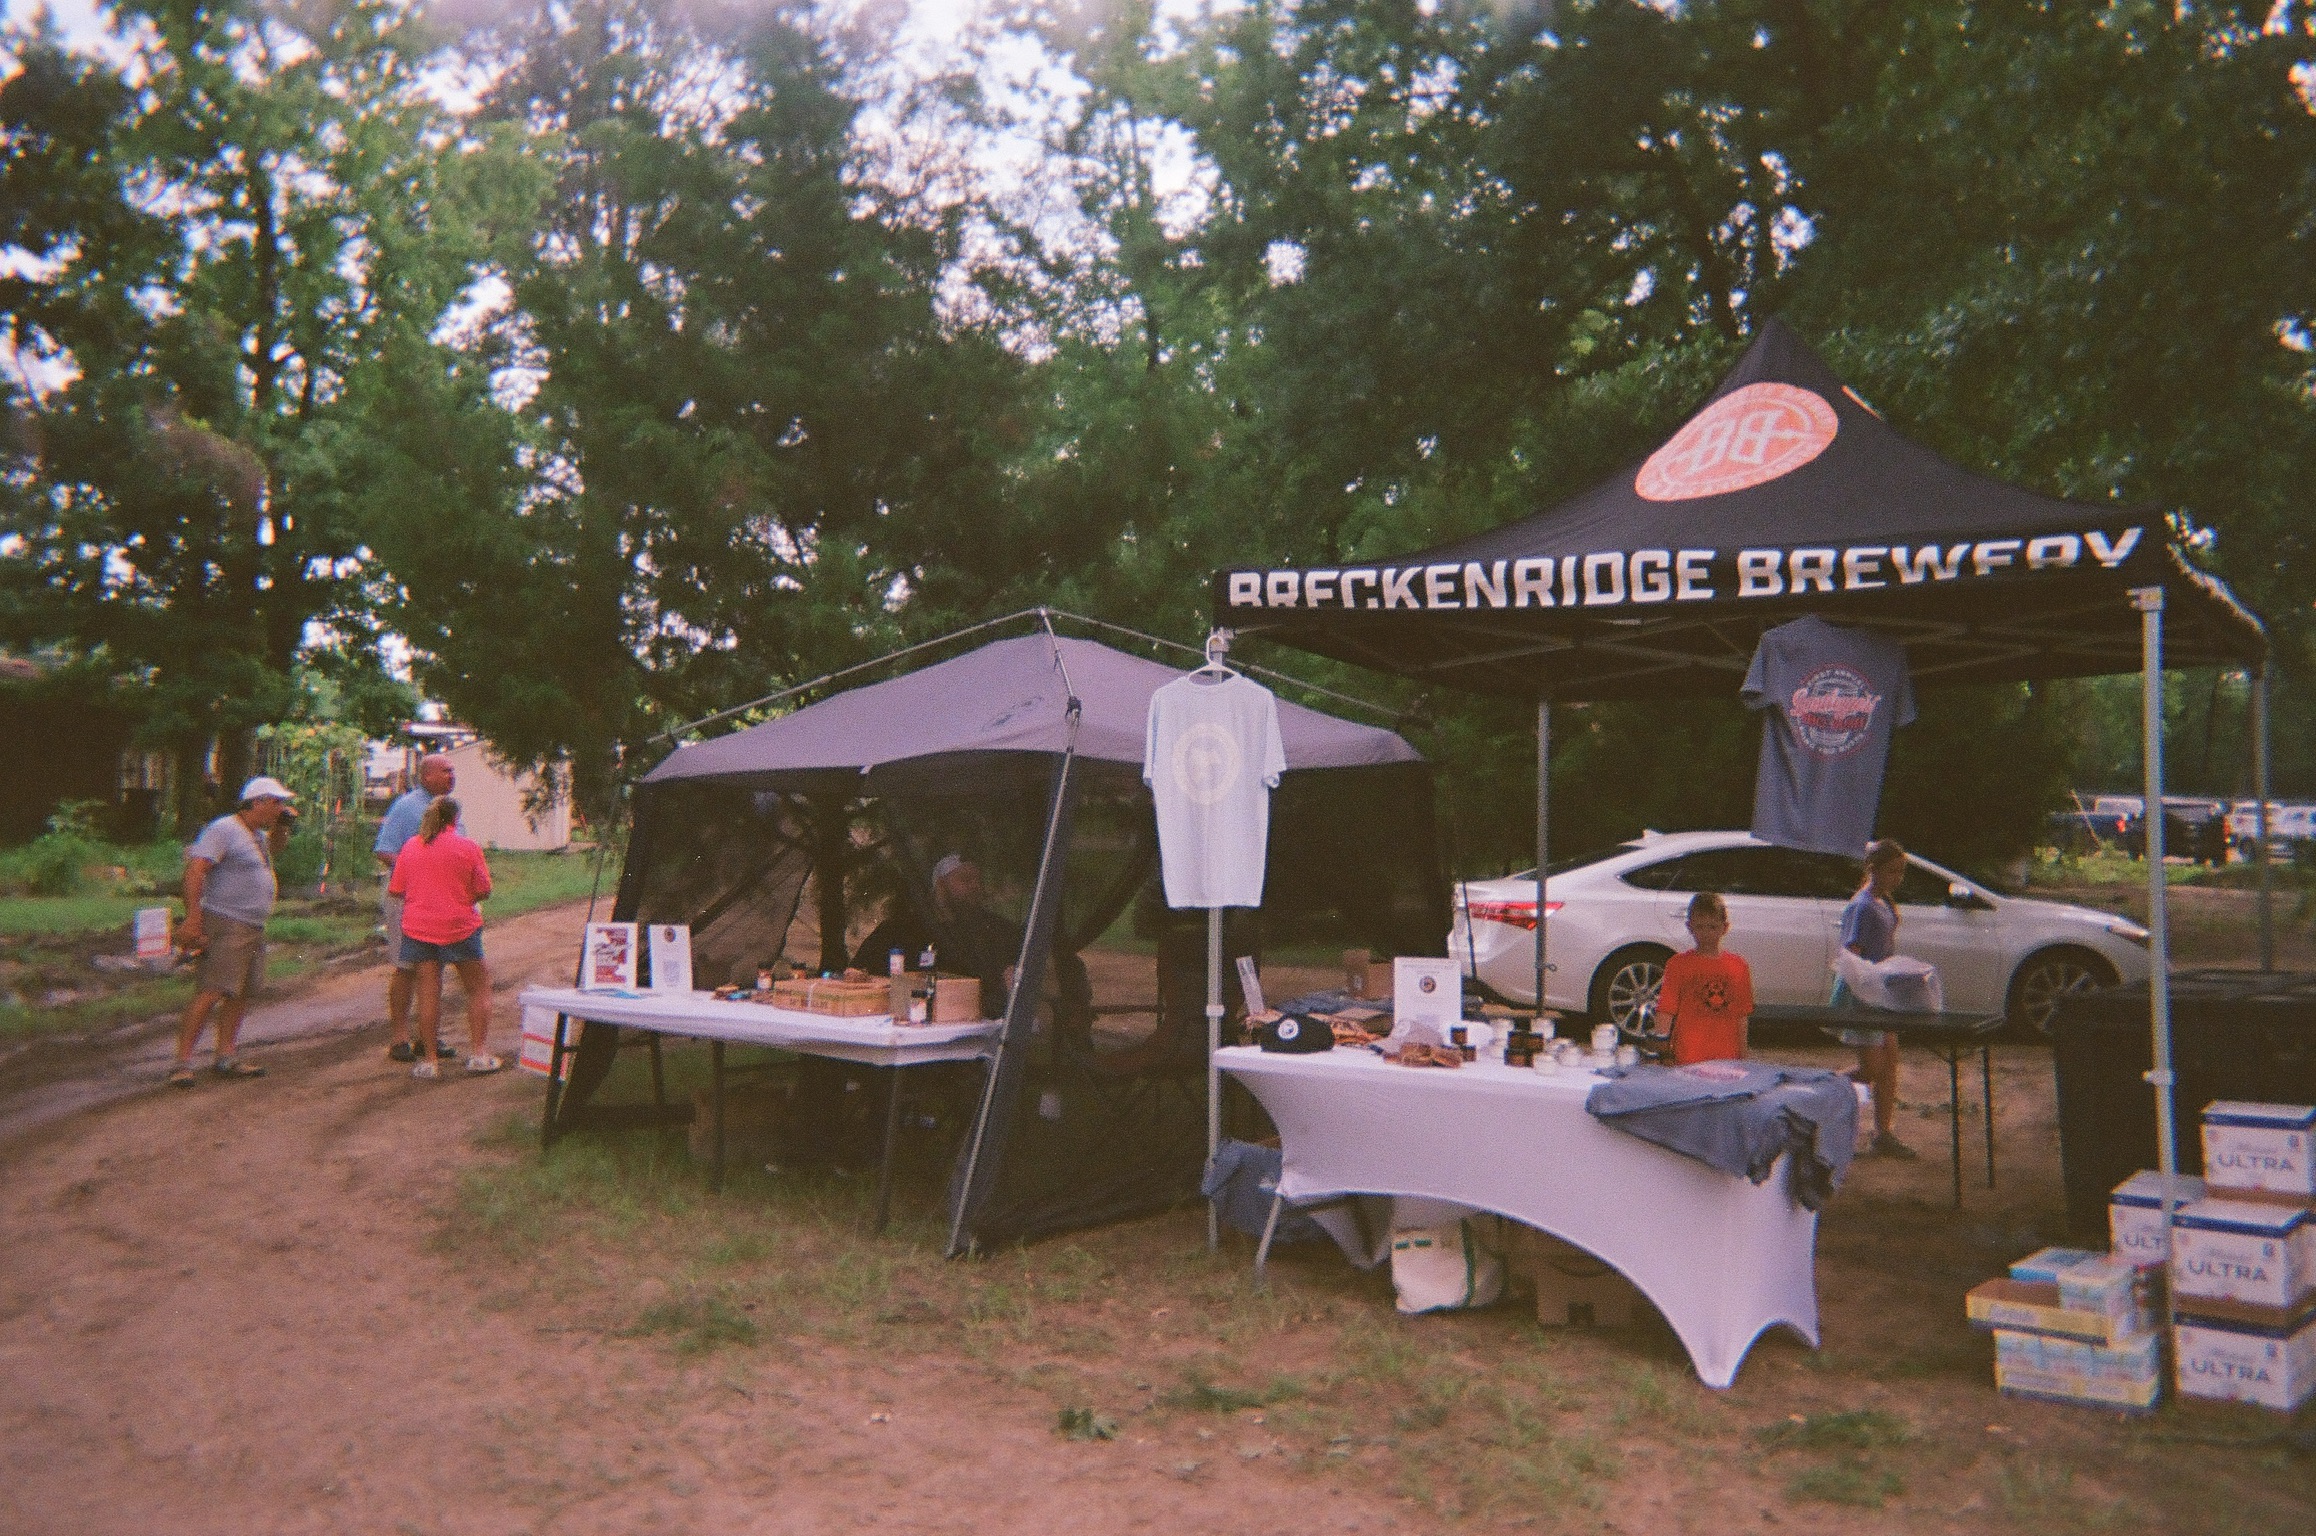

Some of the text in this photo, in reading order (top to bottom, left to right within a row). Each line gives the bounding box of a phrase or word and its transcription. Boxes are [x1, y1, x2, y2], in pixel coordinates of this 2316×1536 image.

[1228, 549, 1717, 609] BRECKENRIDGE
[2217, 1153, 2295, 1172] ULTRA
[2122, 1233, 2162, 1249] ULT
[2186, 1259, 2269, 1282] ULTRA
[2190, 1357, 2271, 1384] ULTRA
